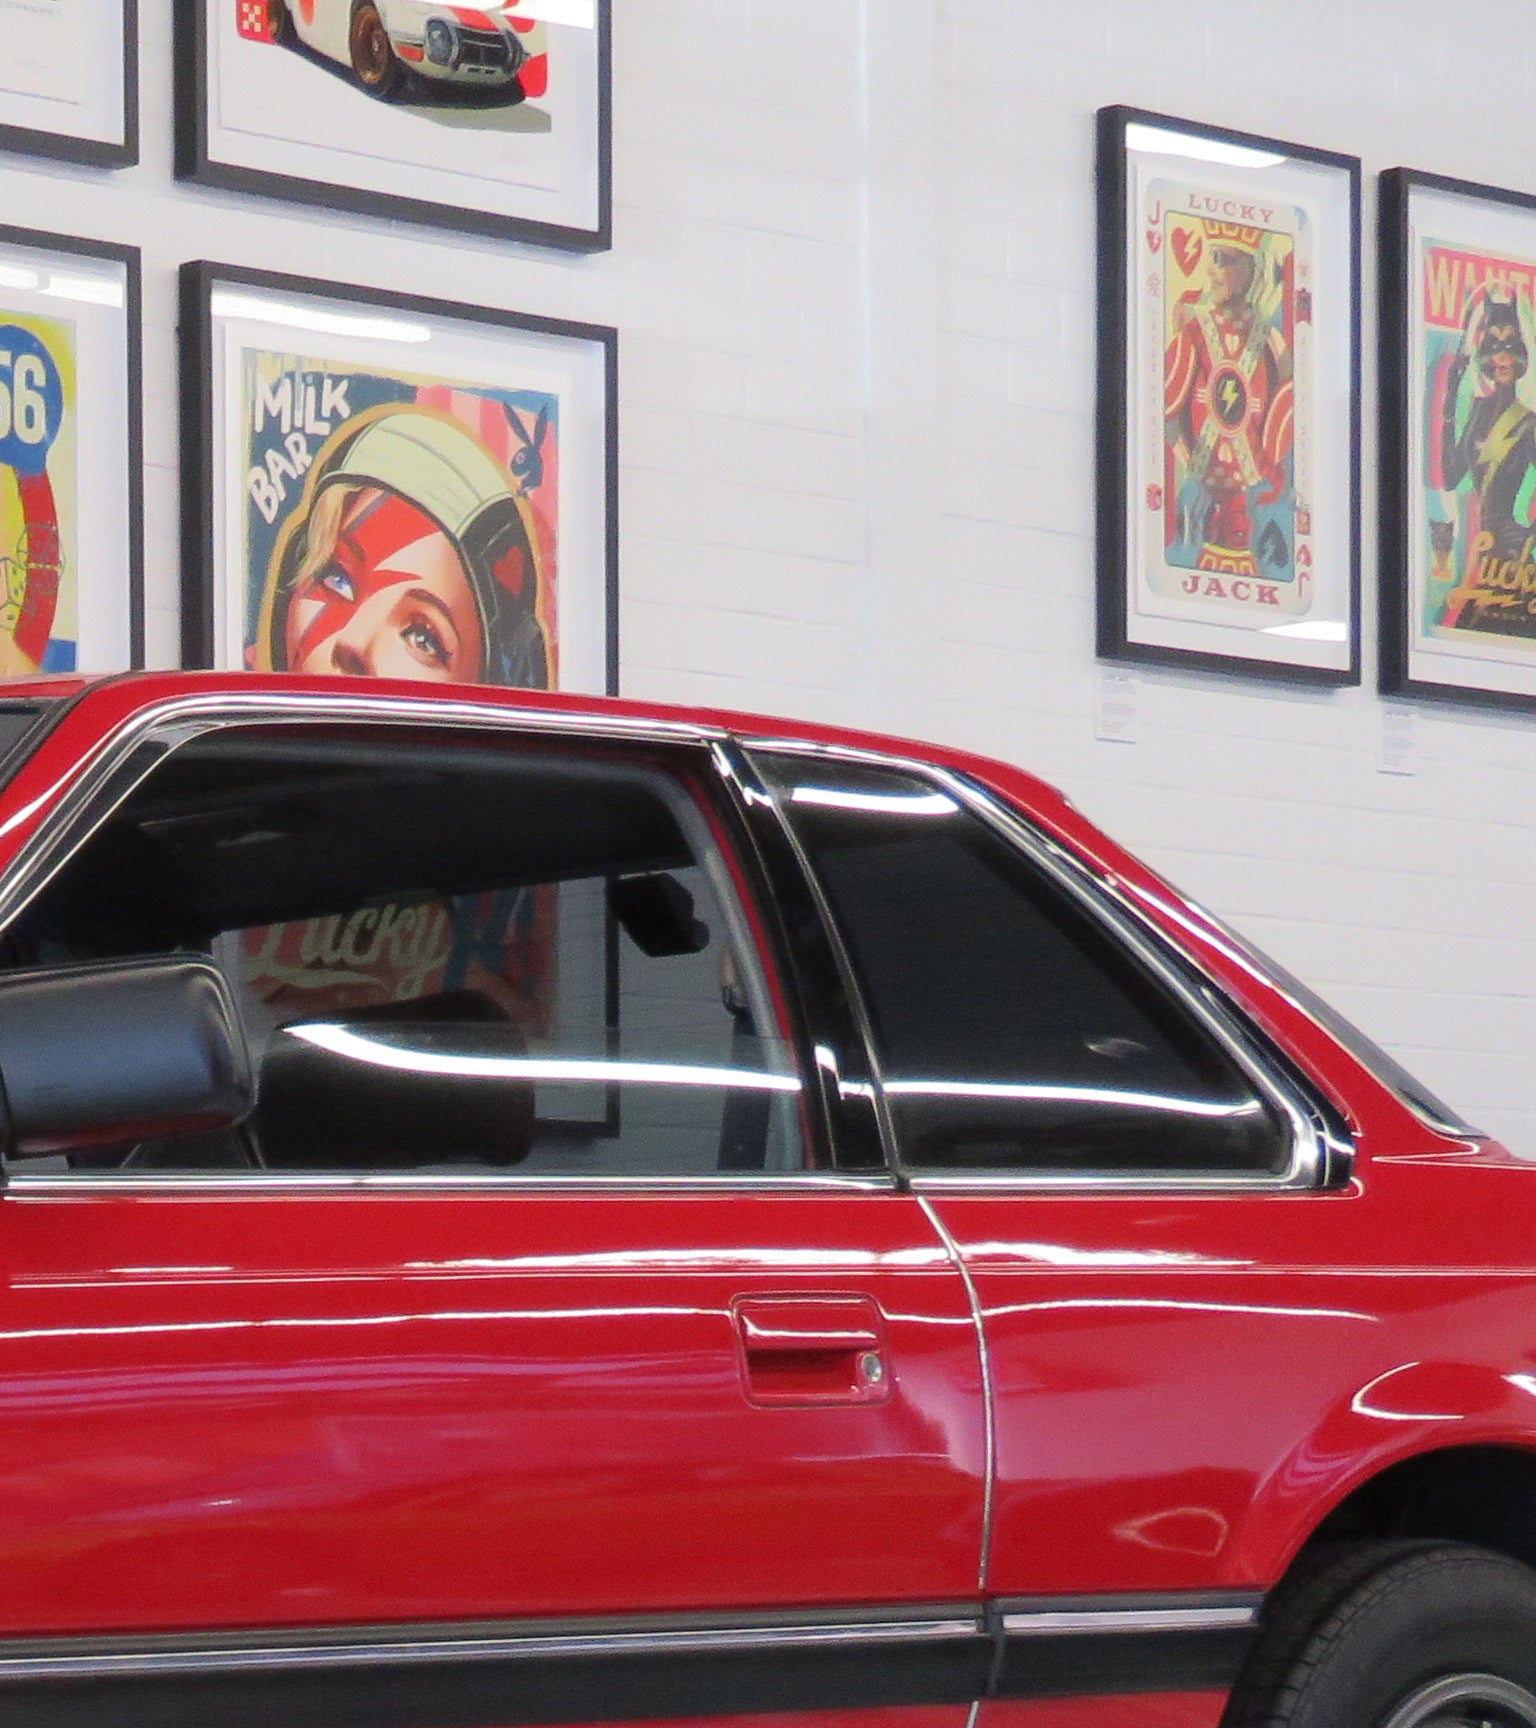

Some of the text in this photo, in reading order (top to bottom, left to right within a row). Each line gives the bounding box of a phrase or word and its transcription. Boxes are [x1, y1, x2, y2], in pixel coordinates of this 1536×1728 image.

[1188, 194, 1275, 223] LUCKY
[247, 432, 314, 524] BAR
[1182, 575, 1280, 605] JACK
